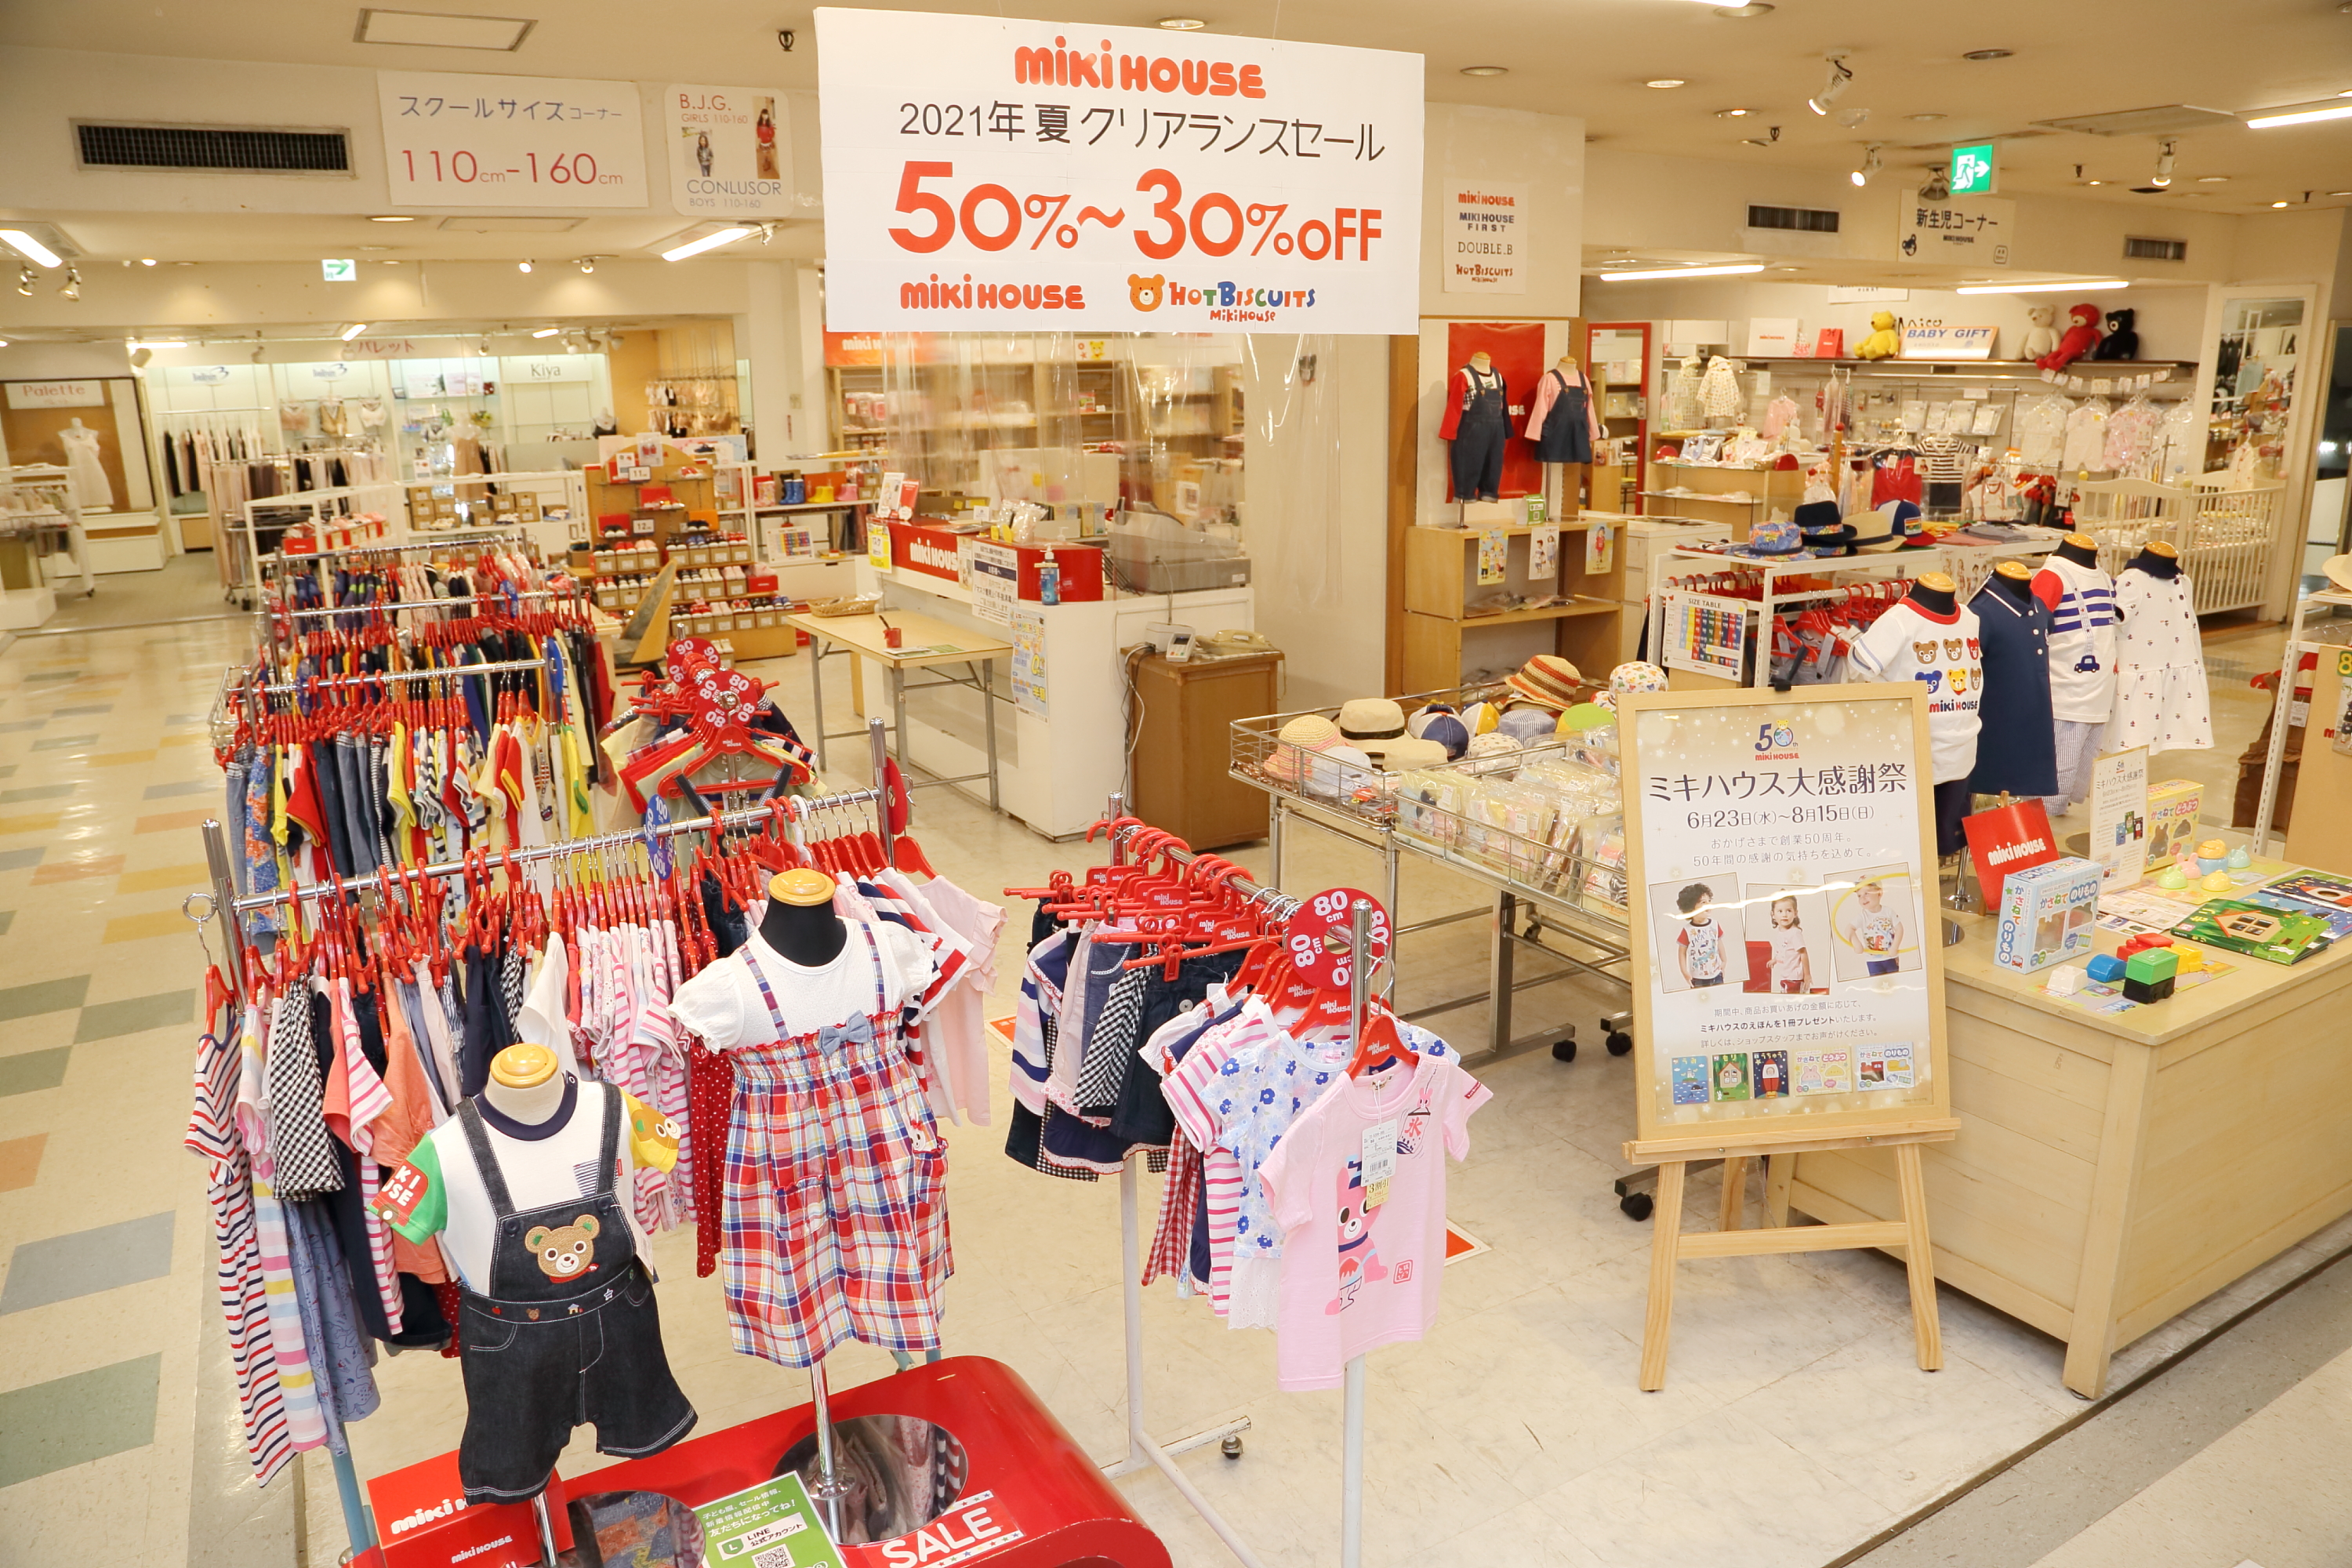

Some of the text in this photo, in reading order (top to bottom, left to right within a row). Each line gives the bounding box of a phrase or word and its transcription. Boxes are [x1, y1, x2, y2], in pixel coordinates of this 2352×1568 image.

[1120, 53, 1266, 99] HOUSE
[679, 93, 732, 111] B.J.G.
[681, 113, 748, 125] GIRLS 110-160
[686, 179, 782, 197] CONLUSOR
[689, 198, 761, 209] BOYS 110-160
[1481, 194, 1515, 207] HOUSE
[1468, 223, 1506, 232] FIRST
[1481, 213, 1515, 223] HOUSE
[1916, 208, 1998, 231] 新生児コーナー
[978, 283, 1086, 310] HOUSE
[1907, 329, 1991, 338] BABY GIFT
[530, 362, 562, 378] Kiya
[22, 383, 86, 397] Palette
[931, 546, 959, 572] HOUS
[1702, 600, 1722, 609] TABLE
[676, 640, 694, 655] 90
[704, 646, 719, 664] 90
[2338, 652, 2352, 675] 8
[699, 680, 717, 699] 80
[729, 674, 750, 691] 80
[730, 686, 740, 695] cm
[1955, 700, 1978, 711] HOUSE
[1648, 762, 1907, 802] ミキハウス大感謝祭
[655, 796, 668, 820] 100
[1711, 831, 1852, 850] おかげさまで創業50周年。
[2013, 837, 2047, 858] HOUSE
[1693, 847, 1871, 867] 50年間の感謝の気持ちを込めて。
[1313, 891, 1348, 916] 80
[2011, 885, 2024, 925] かさねて
[2040, 892, 2069, 910] かさねて
[2071, 881, 2097, 902] のりもの
[1326, 911, 1344, 924] cm
[1290, 934, 1316, 967] 80
[1312, 937, 1323, 954] cm
[2000, 920, 2016, 963] のりもの
[1404, 1116, 1423, 1138] 氷
[395, 1165, 421, 1189] KI
[1368, 1178, 1389, 1194] 3割引
[702, 1488, 782, 1520] 子ども服、セール情報、
[706, 1500, 770, 1529] 新着情報配信中
[476, 1534, 514, 1554] HOUSE
[747, 1528, 771, 1541] LINE
[750, 1523, 804, 1548] 公式アカウント
[882, 1507, 1002, 1568] SALE
